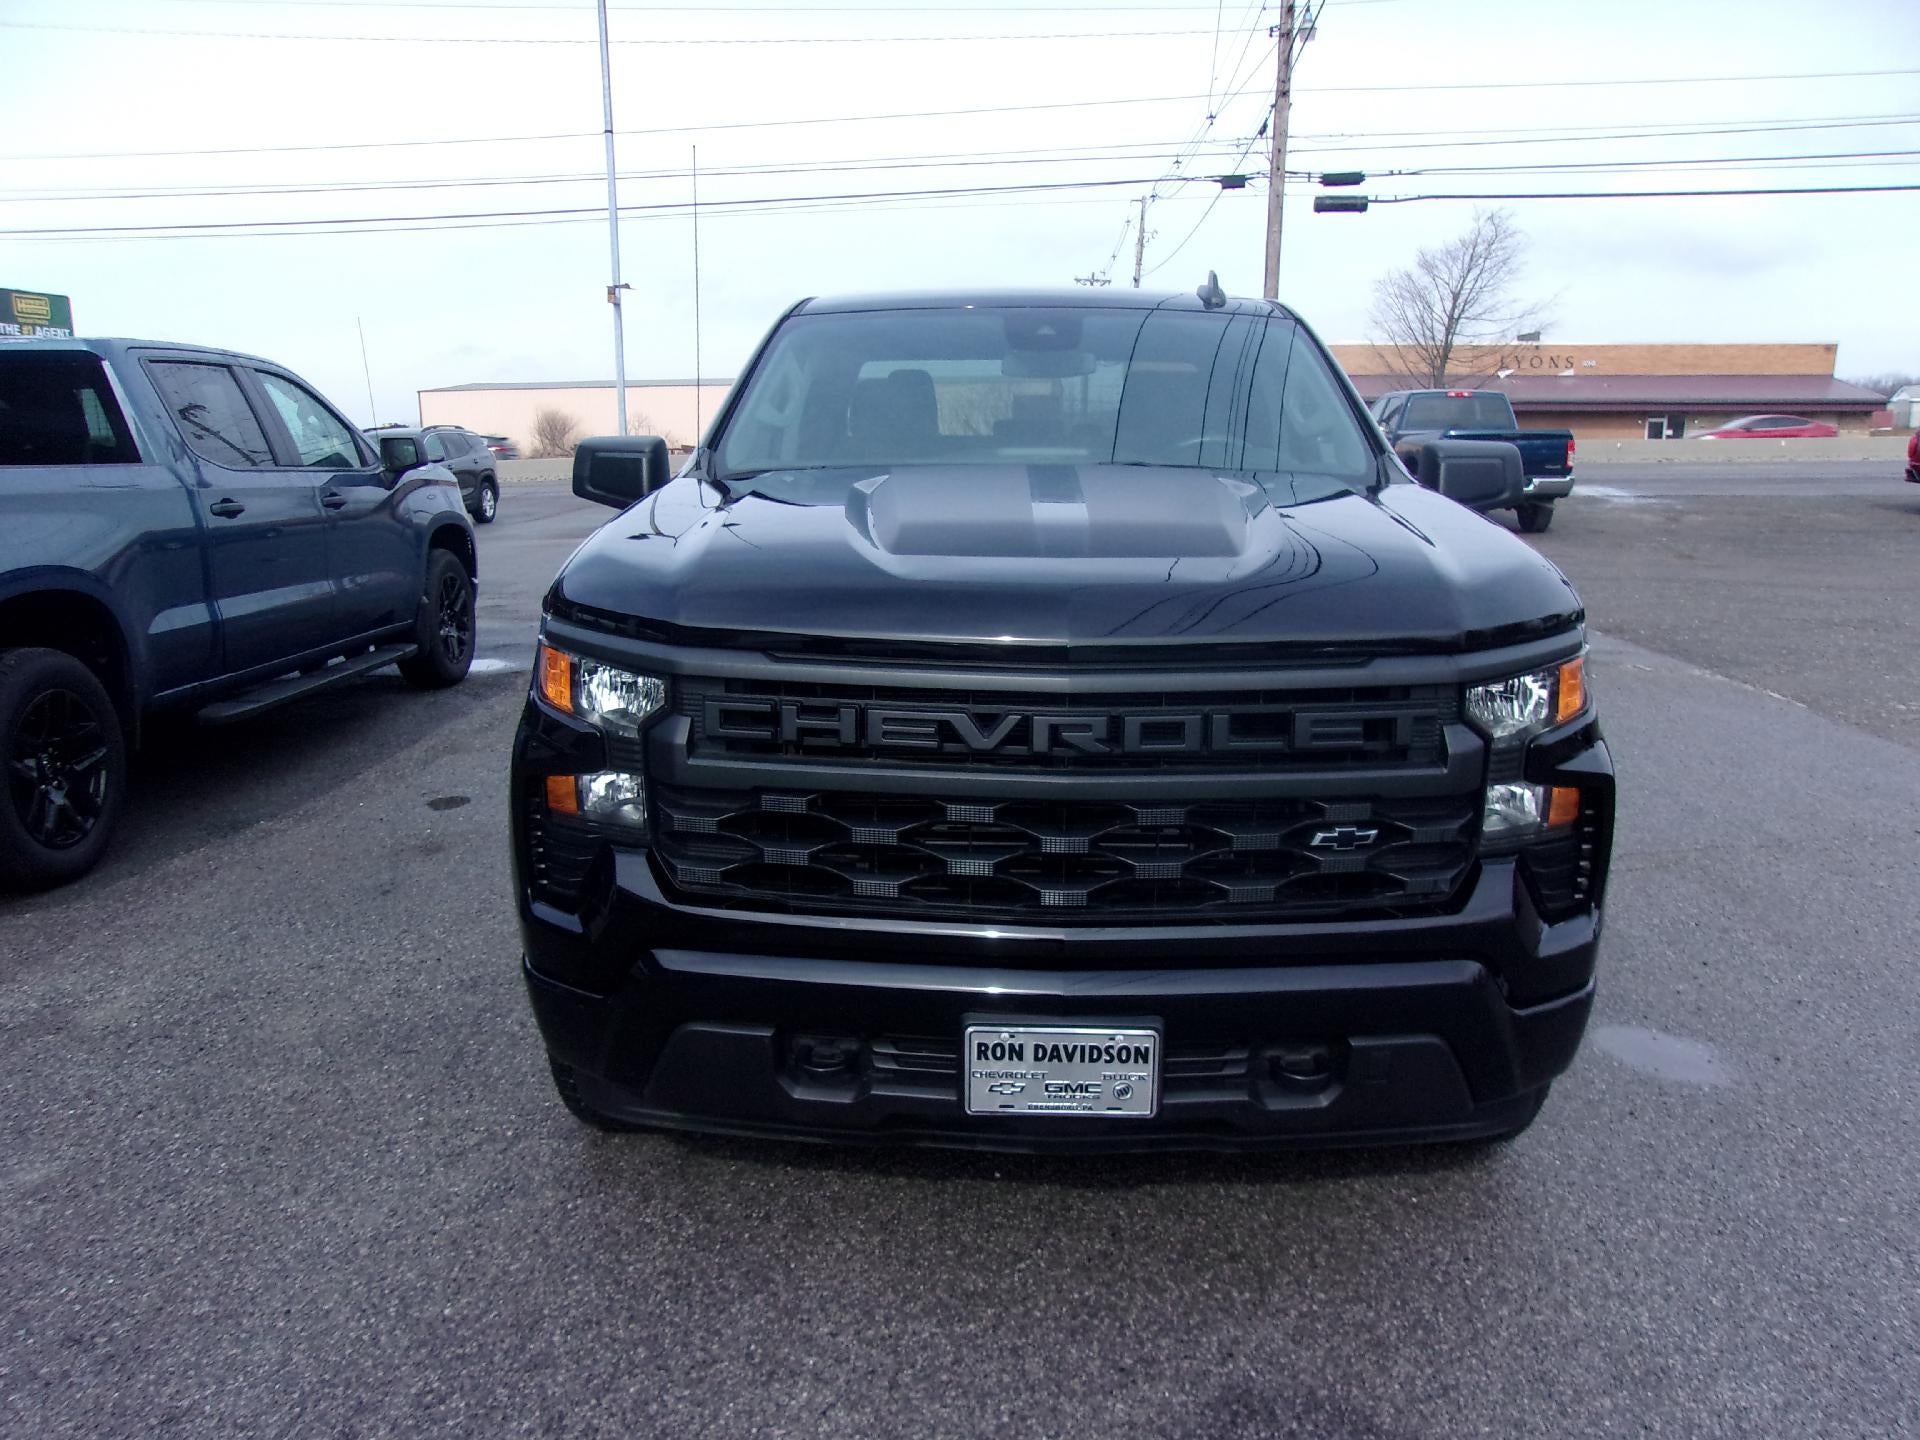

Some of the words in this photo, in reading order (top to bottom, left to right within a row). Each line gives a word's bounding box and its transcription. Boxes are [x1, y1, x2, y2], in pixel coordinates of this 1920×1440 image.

[35, 326, 71, 338] AGENT
[702, 700, 1439, 753] CHEVROLET
[976, 1041, 1024, 1062] RON
[1033, 1043, 1149, 1065] DAVIDSON
[971, 1070, 1048, 1080] CHEVROLET
[1044, 1081, 1102, 1094] GMC
